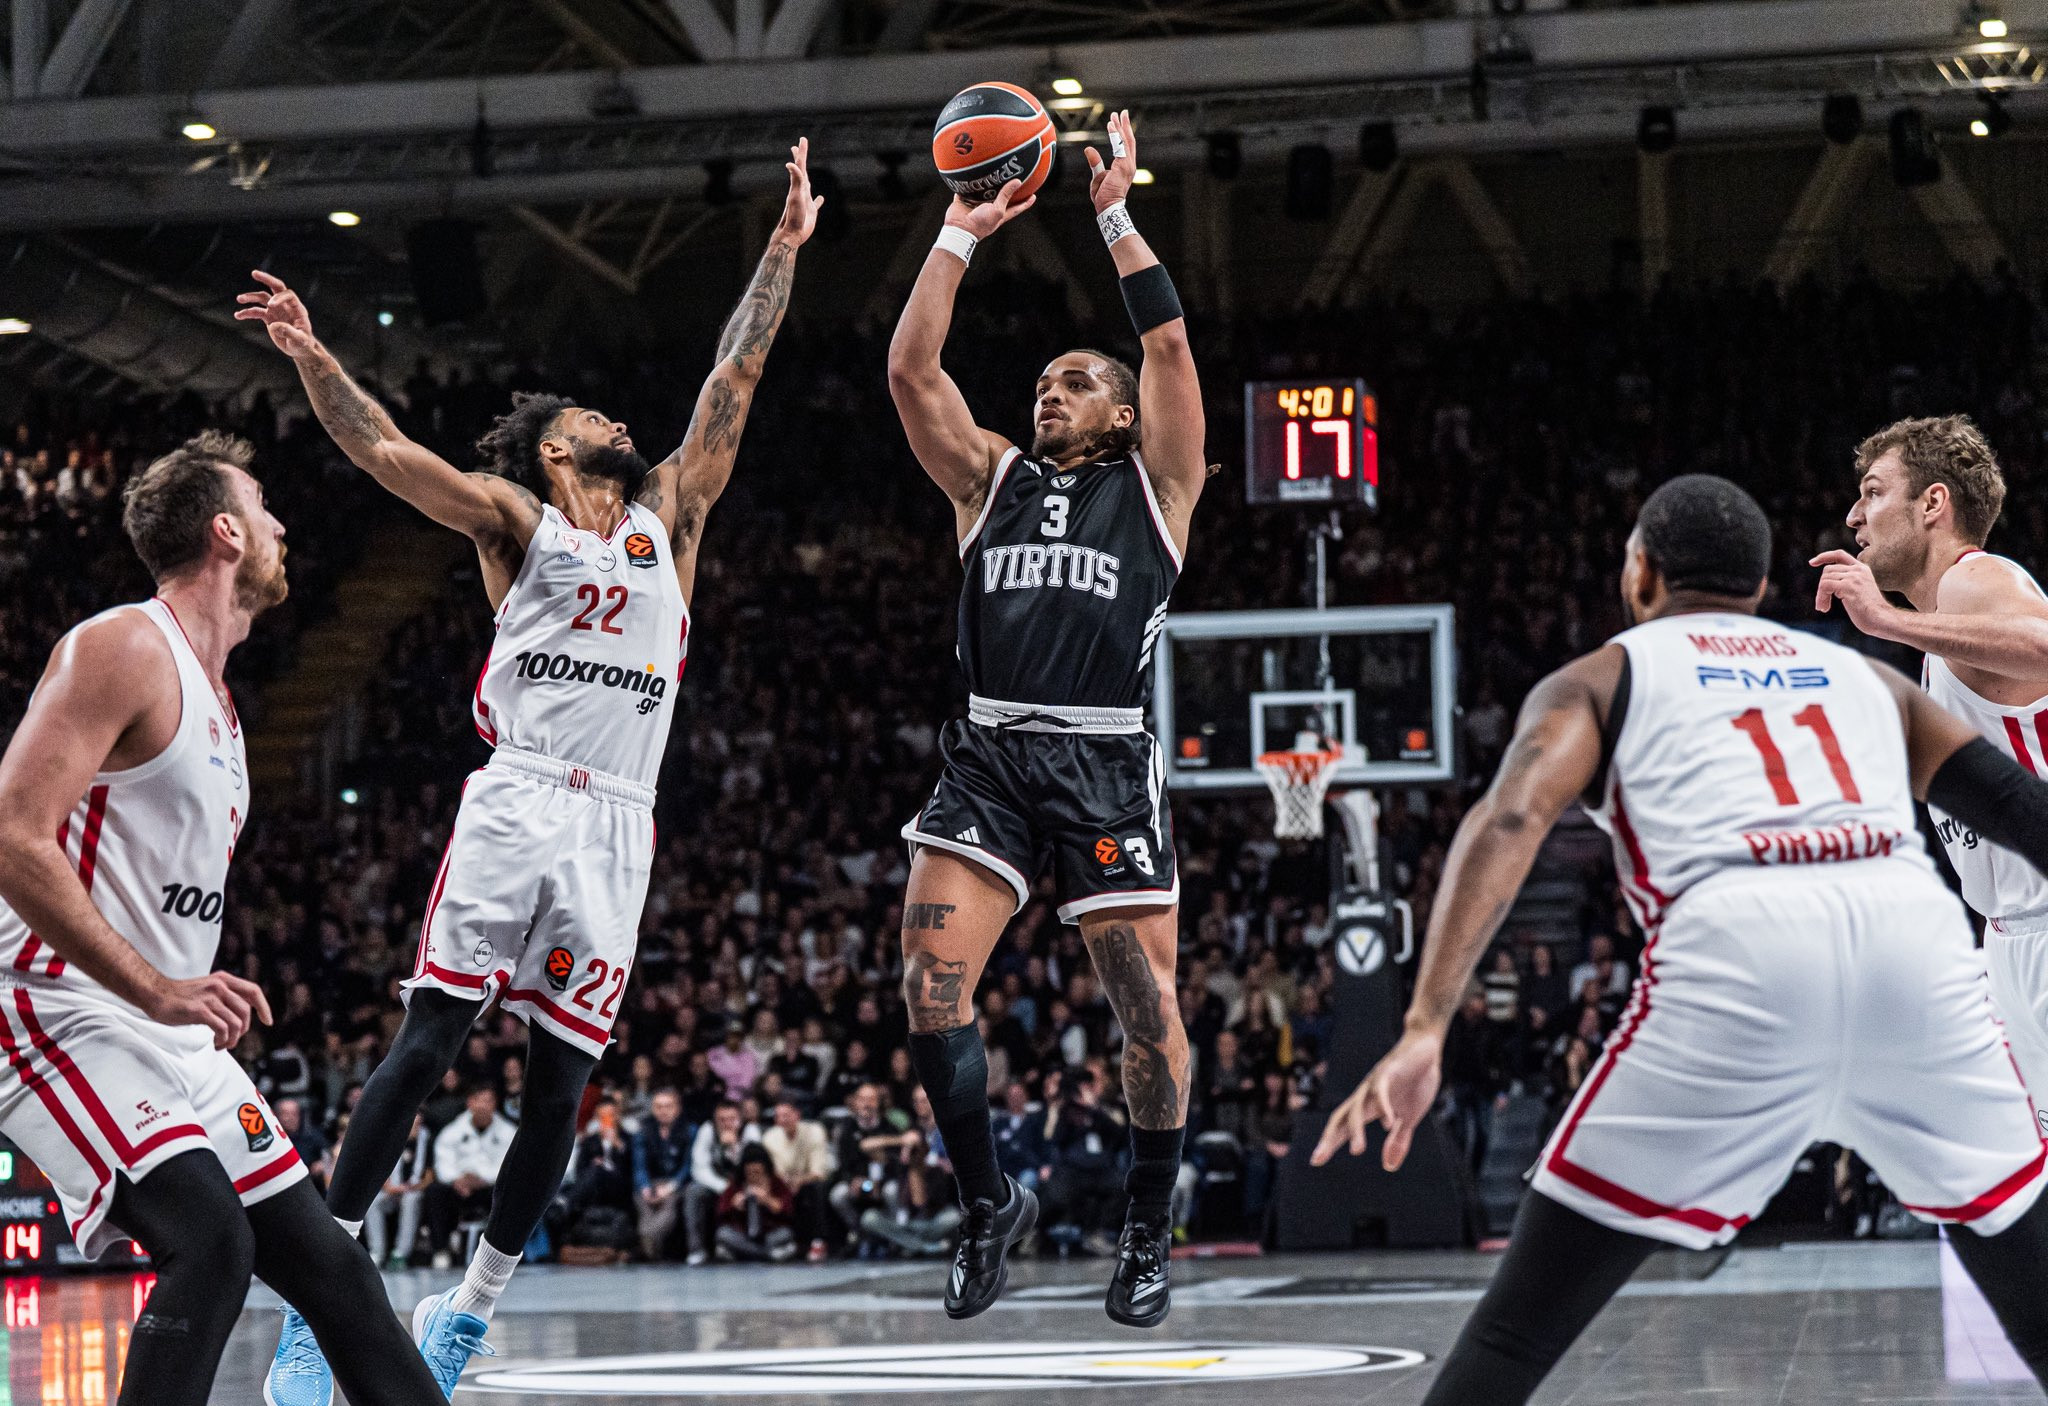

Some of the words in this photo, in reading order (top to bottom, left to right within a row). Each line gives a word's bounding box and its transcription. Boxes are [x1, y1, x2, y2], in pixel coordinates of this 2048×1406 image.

[946, 155, 1024, 195] SPALDING
[1278, 386, 1354, 418] 4:01
[1286, 419, 1351, 480] 17
[1041, 495, 1070, 538] 3
[983, 543, 1120, 600] VIRTUS
[571, 584, 629, 635] 22
[1687, 633, 1797, 657] MORRIS
[515, 651, 667, 699] 100xronia
[636, 698, 660, 715] .gr
[1731, 704, 1862, 806] 11
[1124, 836, 1155, 876] 3
[571, 957, 625, 1020] 22
[135, 1110, 170, 1131] FlexCar
[5, 1224, 41, 1260] 14
